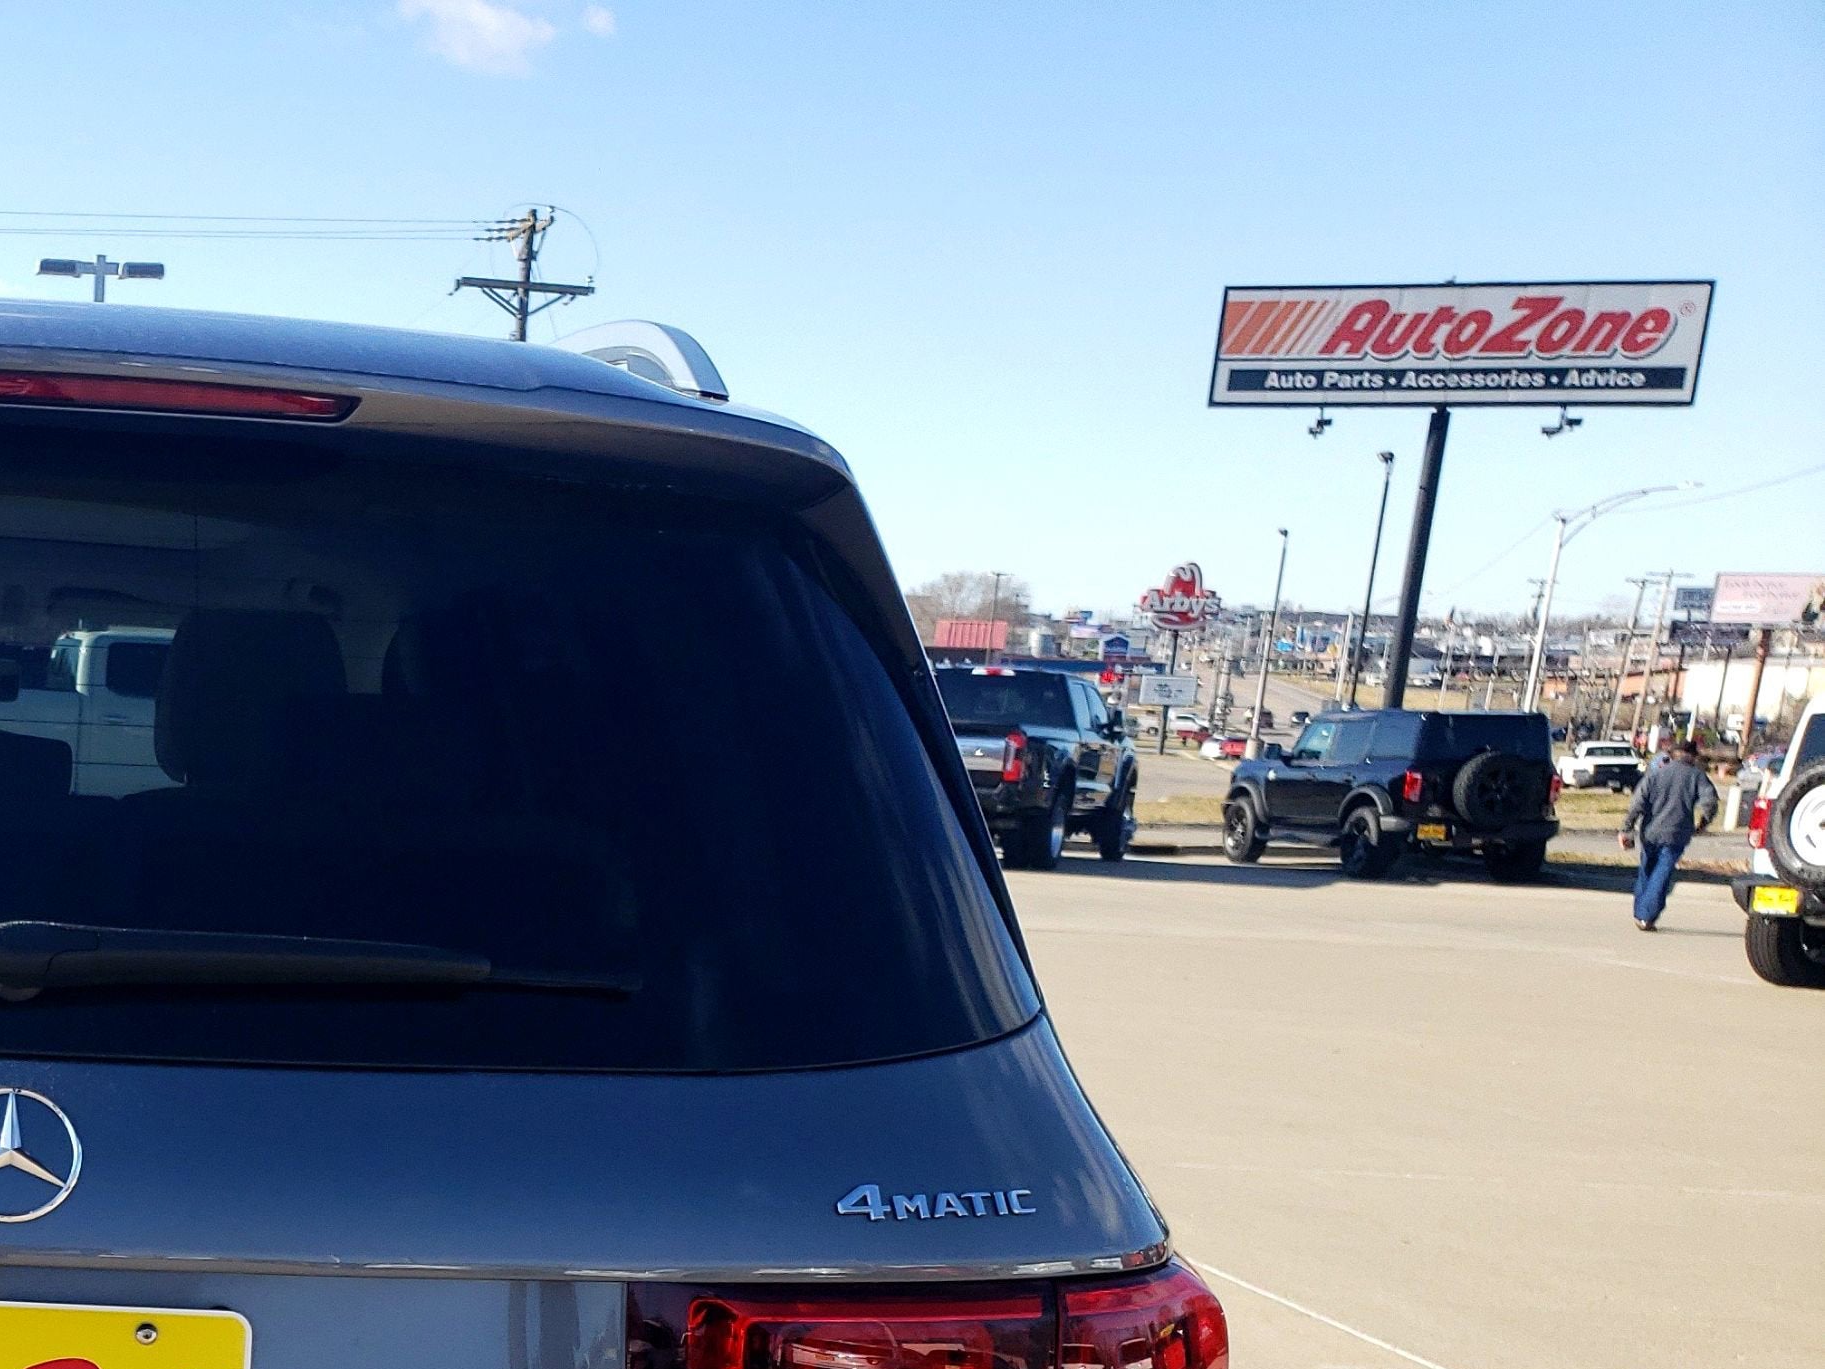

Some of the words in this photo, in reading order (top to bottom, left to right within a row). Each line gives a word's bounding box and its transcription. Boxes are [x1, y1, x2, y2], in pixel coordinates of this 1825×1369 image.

[1317, 295, 1673, 357] AutoZone
[1264, 370, 1317, 389] Auto
[1324, 370, 1384, 389] Parts
[1401, 369, 1545, 389] Accessories
[1564, 368, 1646, 388] Advice
[837, 1184, 1037, 1221] 4MATIC
